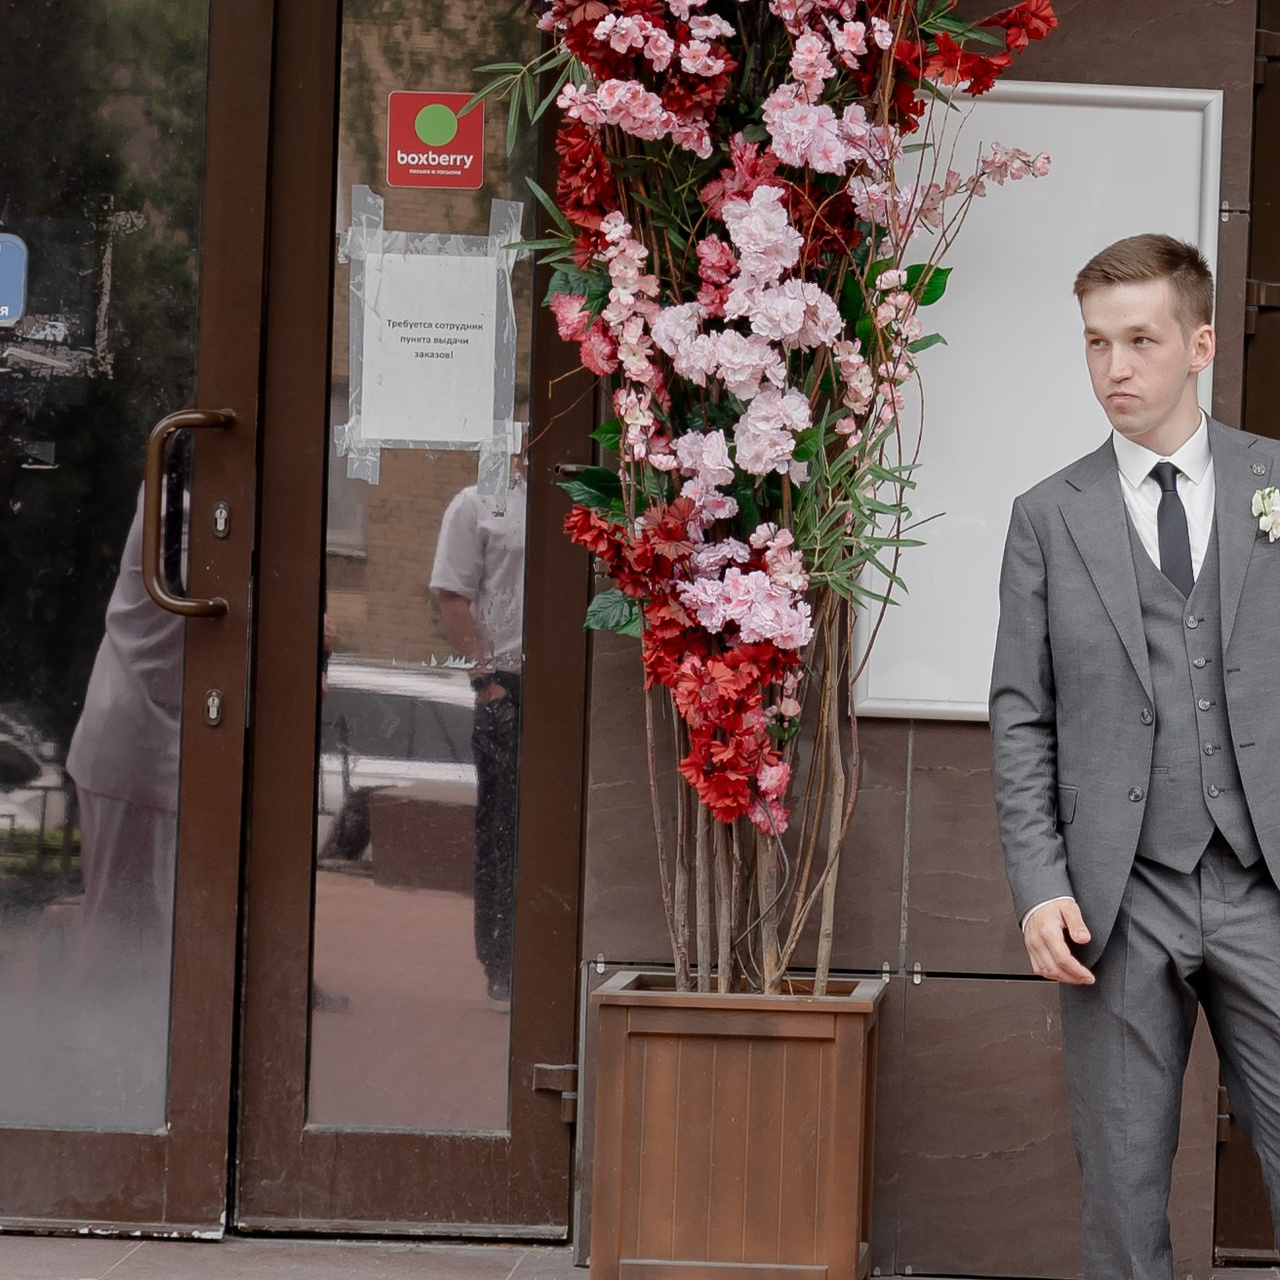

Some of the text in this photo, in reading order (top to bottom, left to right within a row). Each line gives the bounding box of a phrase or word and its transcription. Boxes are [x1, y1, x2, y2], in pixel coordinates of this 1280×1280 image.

[397, 150, 474, 169] boxberry
[386, 319, 483, 331] Требуется сотрудник
[400, 336, 469, 346] пункта выдачи
[414, 350, 454, 360] заказов!
